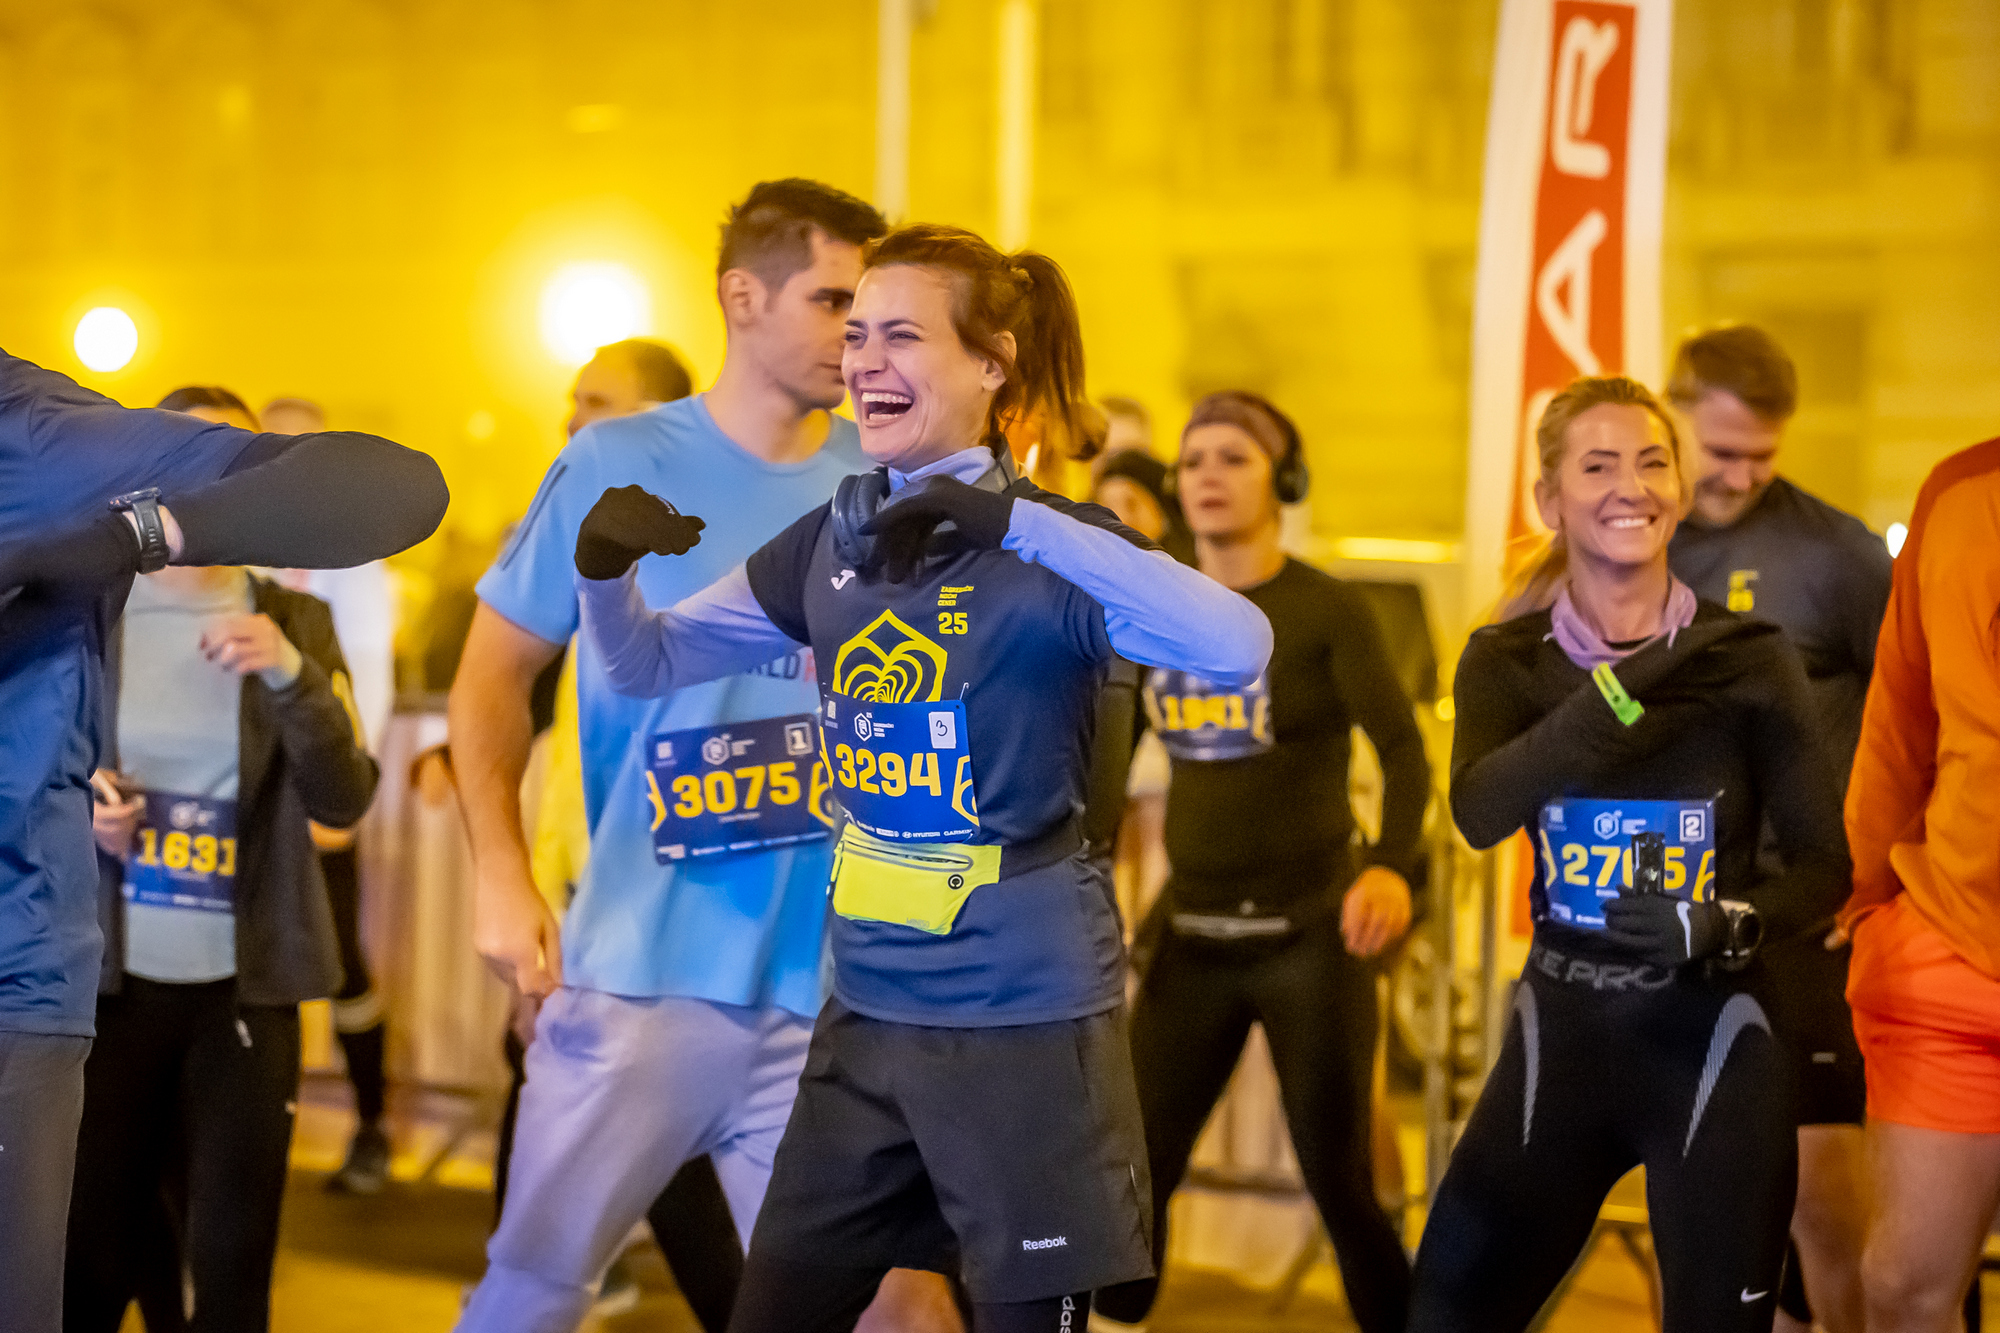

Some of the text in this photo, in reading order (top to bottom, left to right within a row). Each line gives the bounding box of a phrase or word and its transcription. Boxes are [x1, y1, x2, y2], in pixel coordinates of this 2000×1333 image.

[938, 612, 968, 635] 25
[790, 729, 807, 750] 1
[935, 719, 948, 737] 3
[835, 743, 942, 797] 3294
[672, 761, 801, 819] 3075
[1685, 816, 1700, 837] 2
[136, 827, 237, 877] 1631
[1564, 958, 1676, 991] PRO
[1022, 1235, 1068, 1251] Reebok
